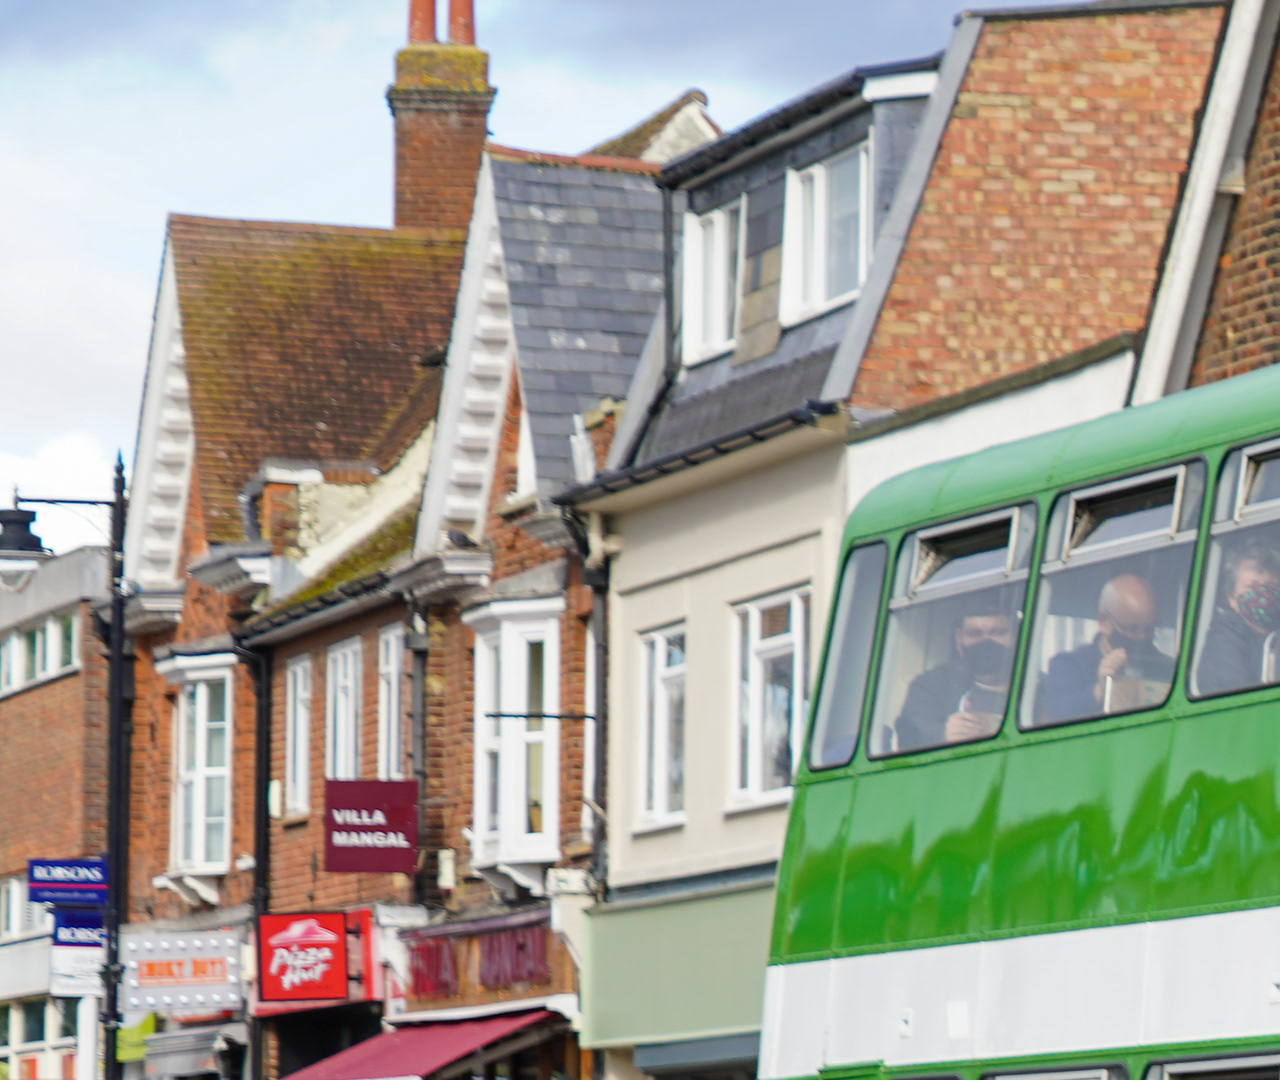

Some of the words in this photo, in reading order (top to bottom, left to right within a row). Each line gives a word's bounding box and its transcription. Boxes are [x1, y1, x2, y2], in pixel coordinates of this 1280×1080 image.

[332, 809, 387, 826] VILLA
[332, 830, 411, 848] MANGAL
[269, 944, 334, 976] Pizza
[280, 962, 330, 991] Hut
